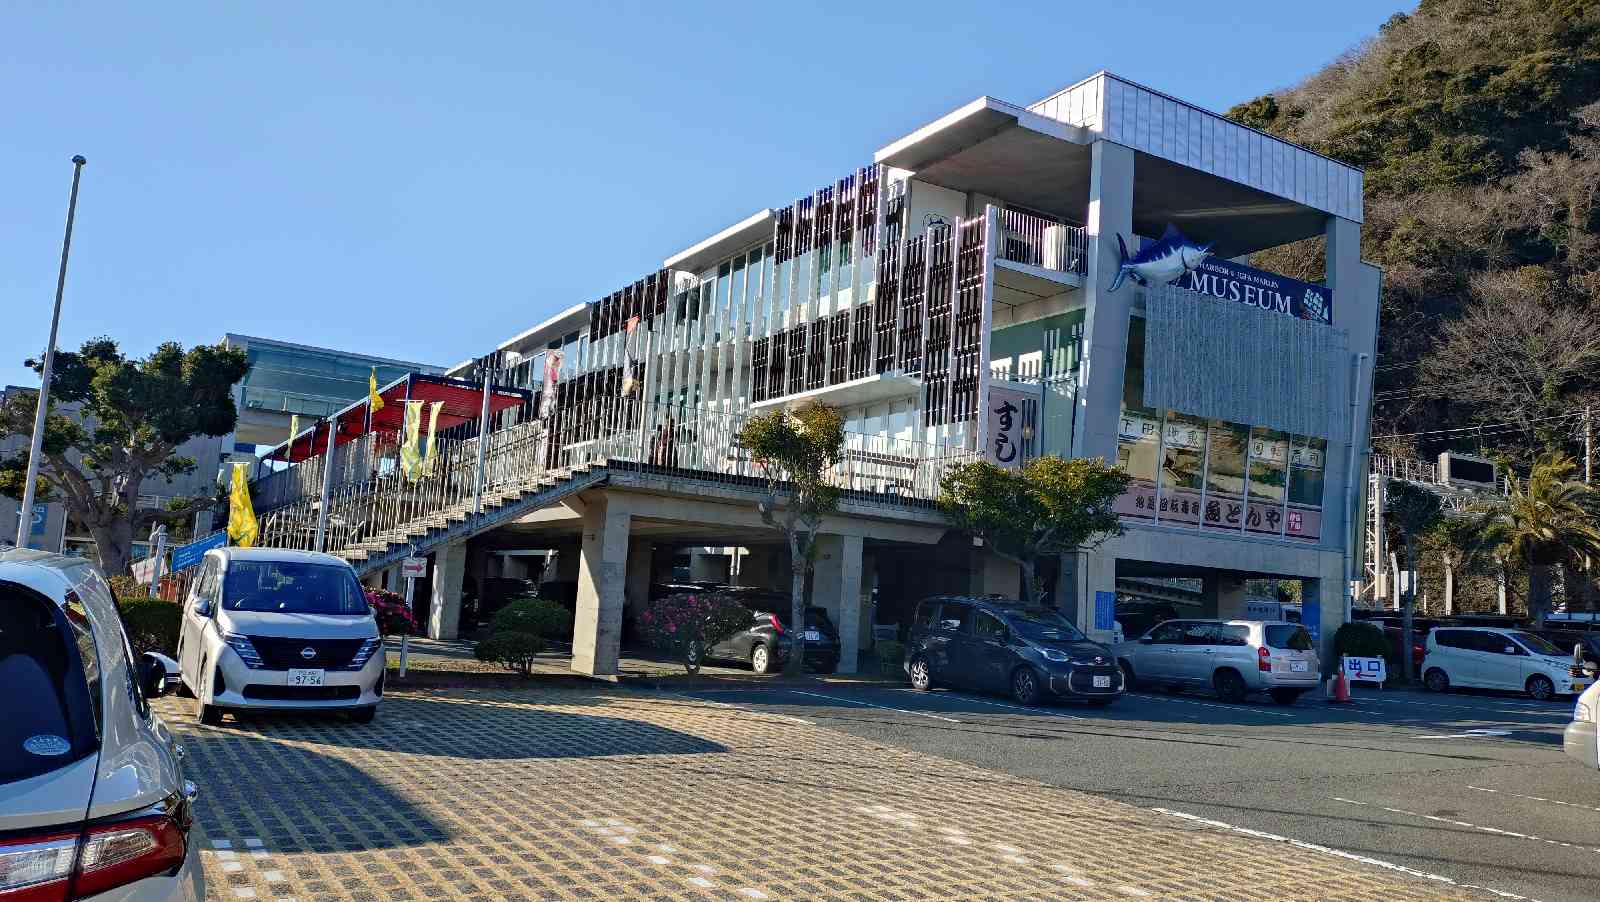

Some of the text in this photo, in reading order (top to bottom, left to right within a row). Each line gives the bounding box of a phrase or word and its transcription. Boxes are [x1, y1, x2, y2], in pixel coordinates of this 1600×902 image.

[1200, 262, 1229, 276] HARBOR
[1189, 270, 1293, 316] MUSEUM
[993, 400, 1019, 463] すし
[1348, 659, 1381, 672] 出口
